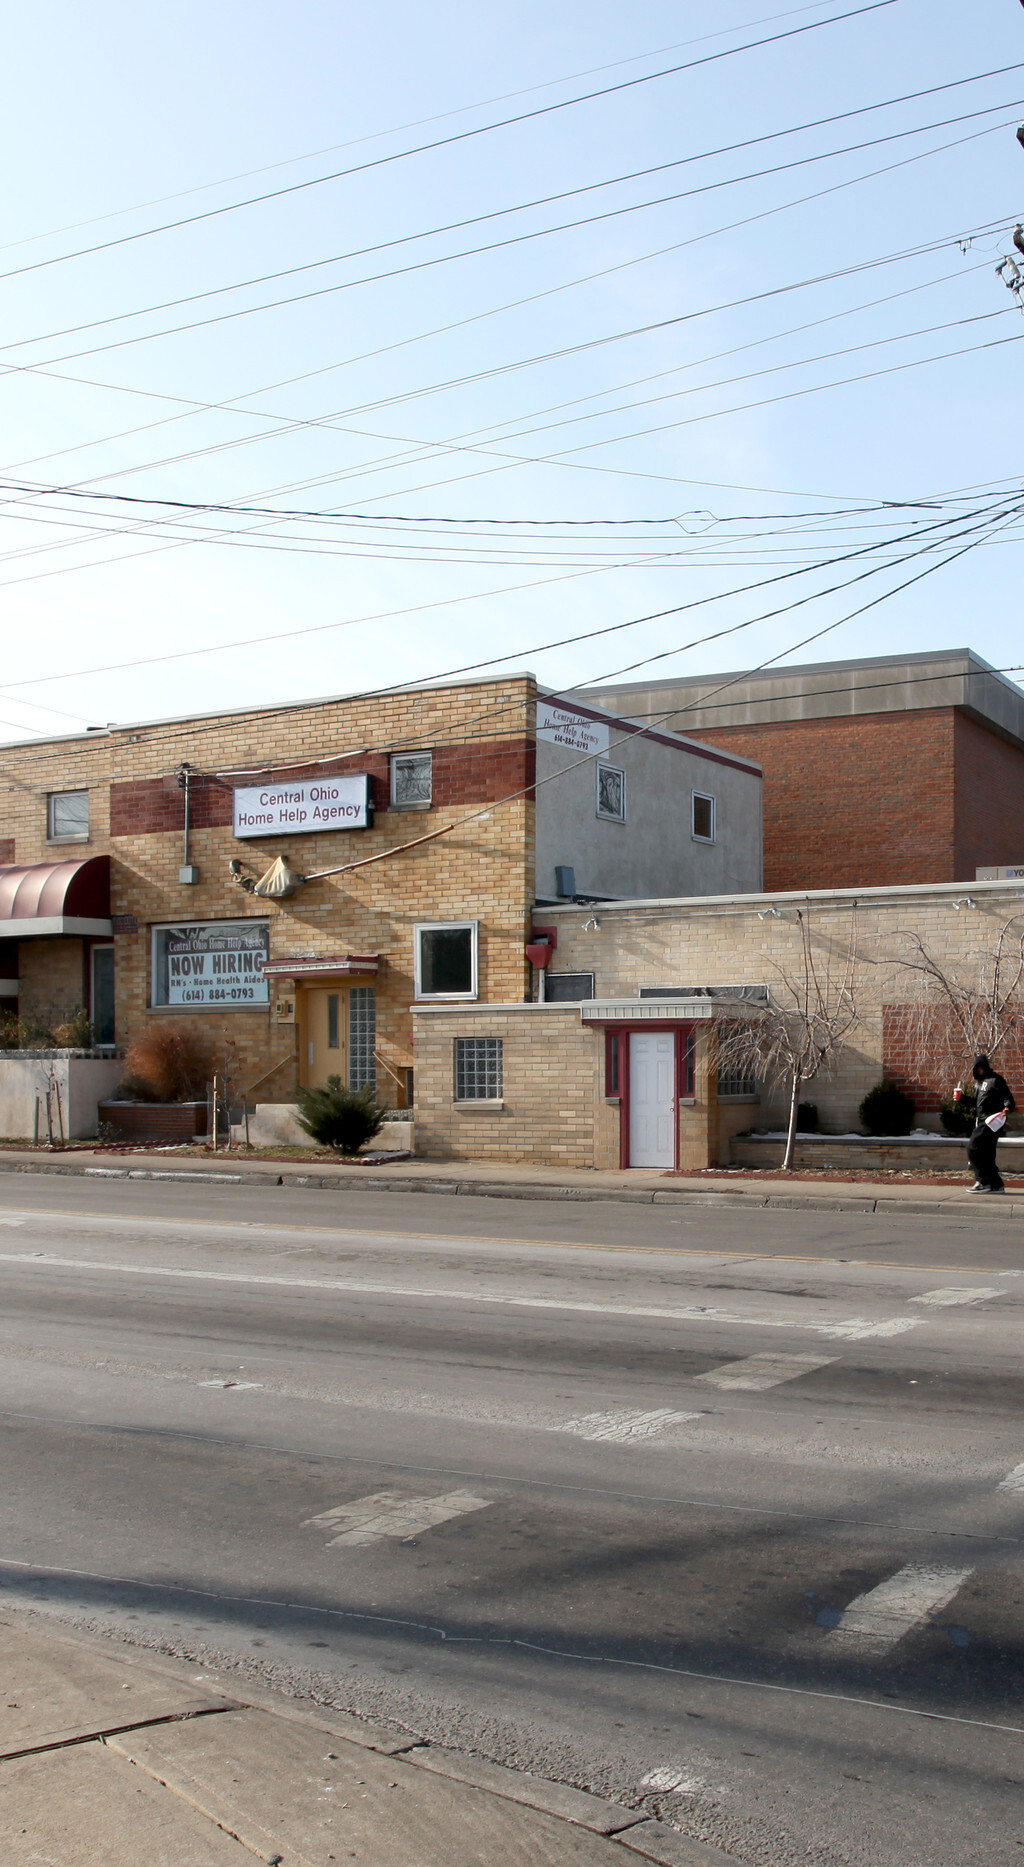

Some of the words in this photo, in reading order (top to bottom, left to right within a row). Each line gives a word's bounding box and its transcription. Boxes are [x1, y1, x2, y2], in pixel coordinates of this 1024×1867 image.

[553, 709, 576, 724] Central
[554, 734, 589, 750] 614-884-0793
[563, 725, 577, 738] Help
[580, 731, 599, 745] Agency
[260, 789, 304, 807] Central
[310, 787, 339, 801] Ohio
[239, 813, 274, 826] Home
[280, 808, 307, 823] Help
[313, 804, 361, 822] Agency
[169, 941, 191, 952] Central
[193, 939, 208, 951] Ohio
[209, 937, 226, 949] Home
[228, 936, 241, 949] Help
[244, 937, 265, 949] Agency
[171, 955, 205, 977] NOW
[212, 952, 264, 974] HIRING
[171, 978, 187, 987] RN's
[194, 978, 213, 986] Home
[216, 975, 241, 985] Health
[244, 974, 265, 984] Aides
[182, 990, 205, 1002] (614)
[209, 988, 255, 1000] 884-0793
[980, 1081, 987, 1091] R
